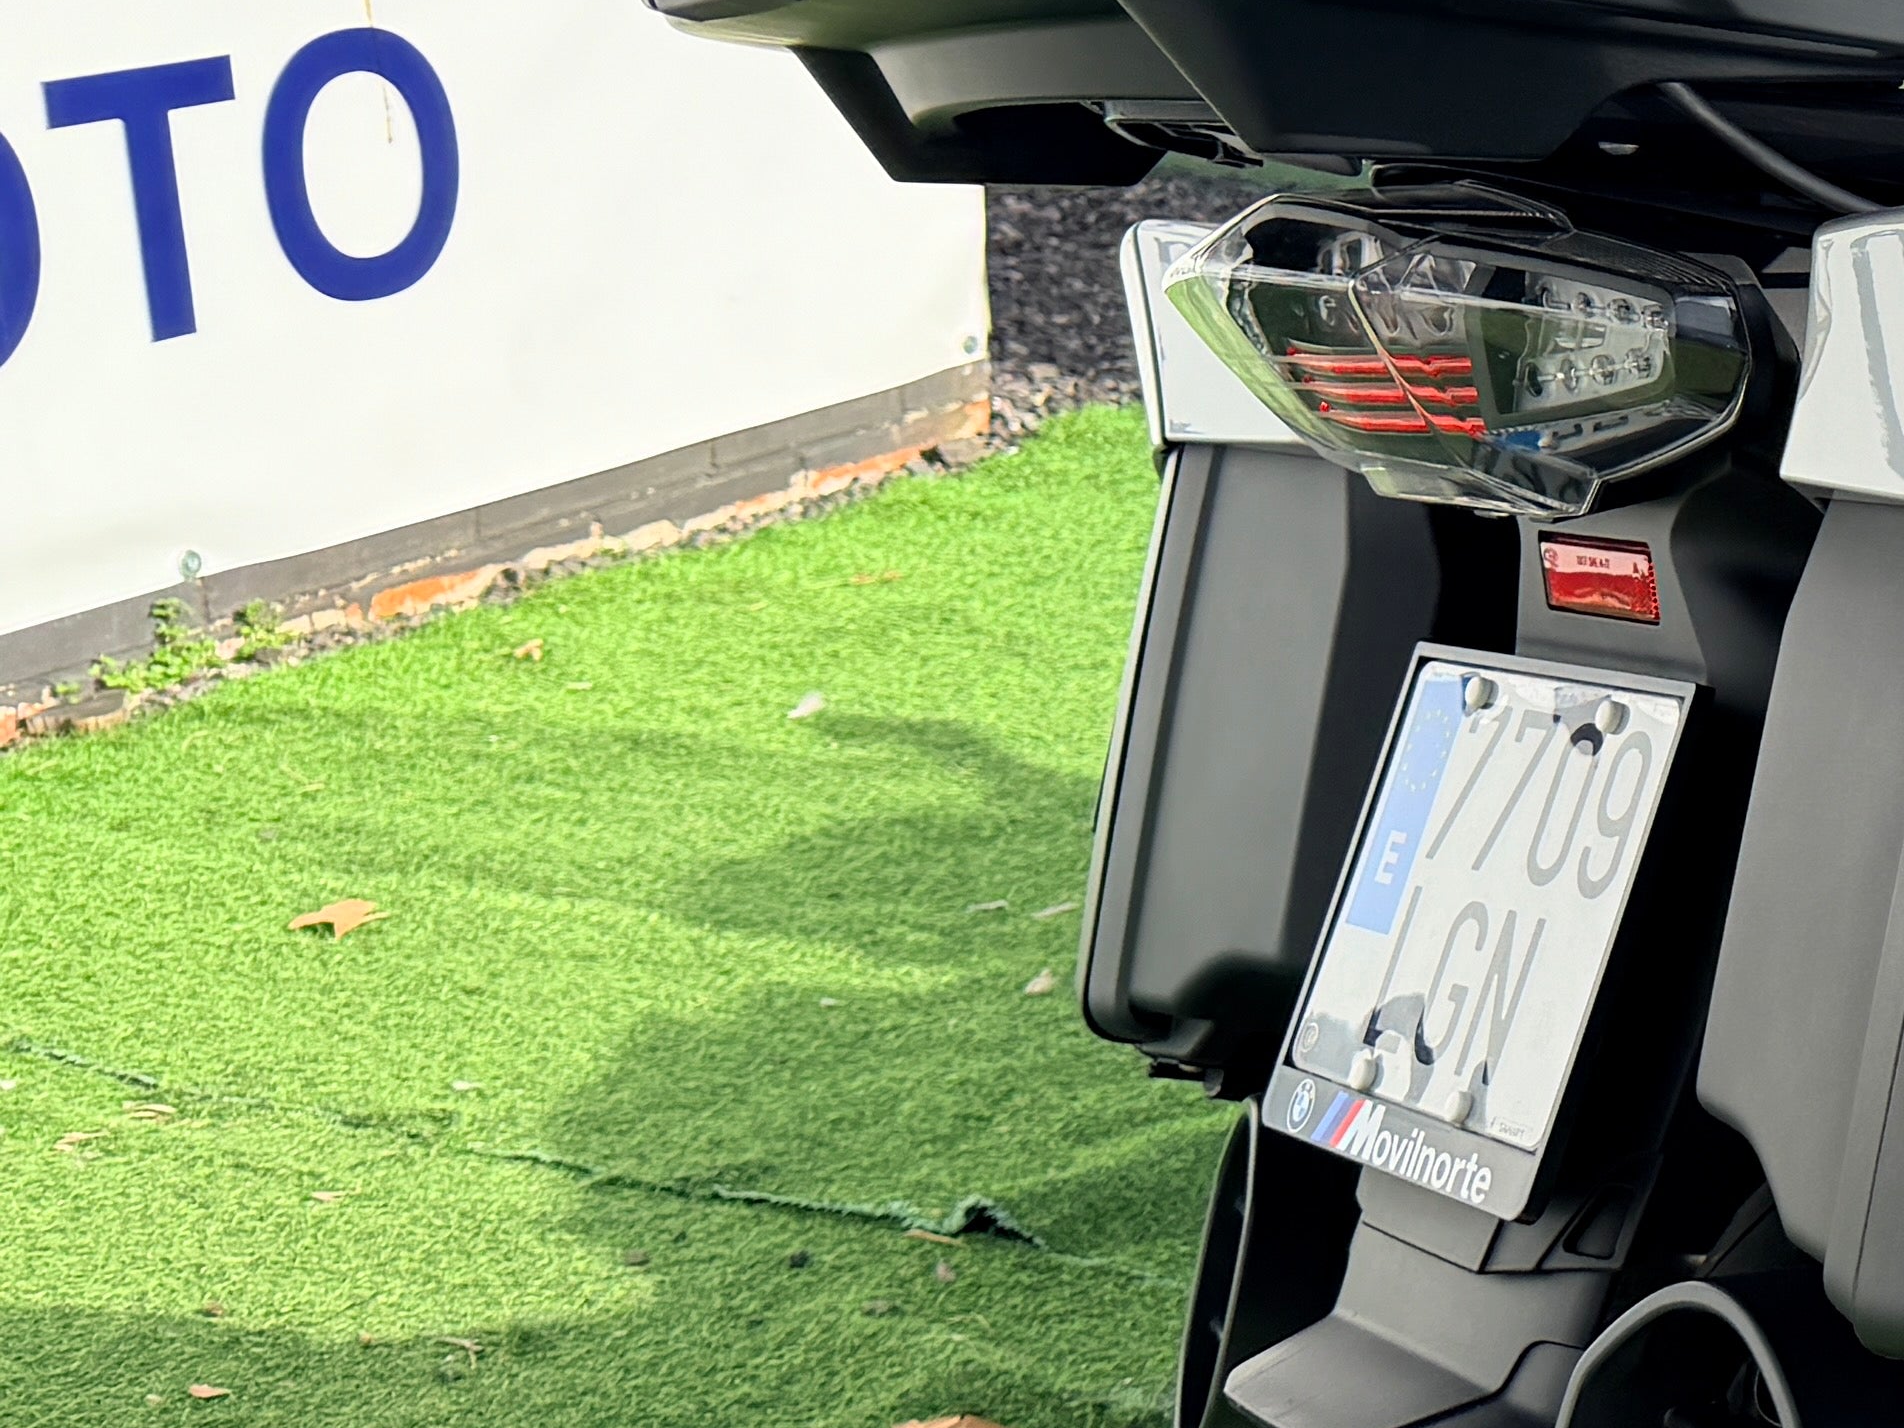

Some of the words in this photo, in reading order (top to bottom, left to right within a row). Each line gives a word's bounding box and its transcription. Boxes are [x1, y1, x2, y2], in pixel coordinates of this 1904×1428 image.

[0, 28, 460, 370] TO
[1375, 832, 1406, 886] E
[1425, 700, 1653, 900] 7709
[1364, 884, 1546, 1085] LGN
[1336, 1099, 1492, 1204] Movilnorte
